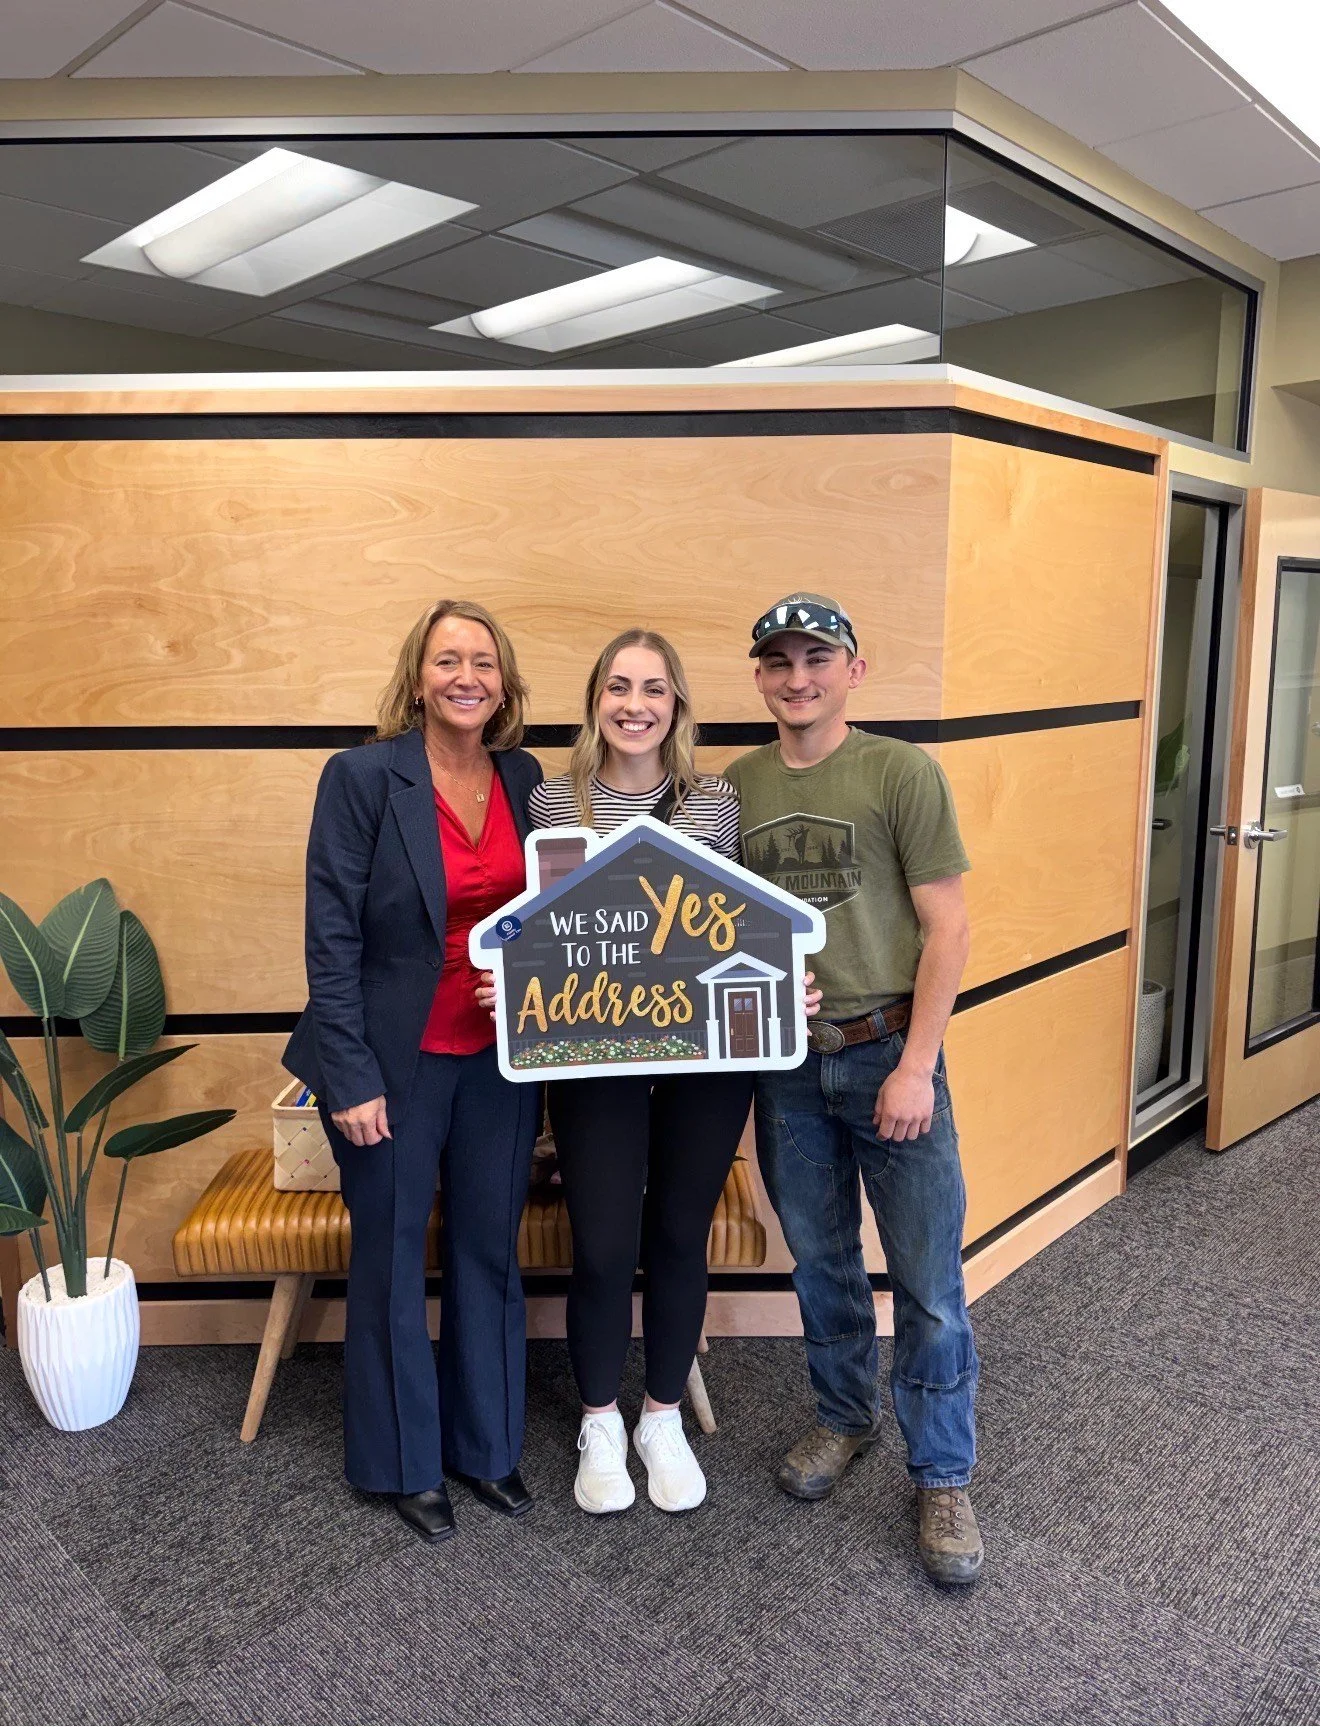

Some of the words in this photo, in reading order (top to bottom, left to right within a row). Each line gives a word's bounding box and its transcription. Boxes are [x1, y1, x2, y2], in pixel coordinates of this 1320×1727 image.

[785, 870, 862, 890] MOUNTAIN
[550, 911, 589, 936] WE
[595, 909, 649, 934] SAID
[639, 874, 746, 955] Yes
[561, 942, 591, 968] TO
[596, 941, 641, 966] THE
[517, 971, 693, 1034] Address
